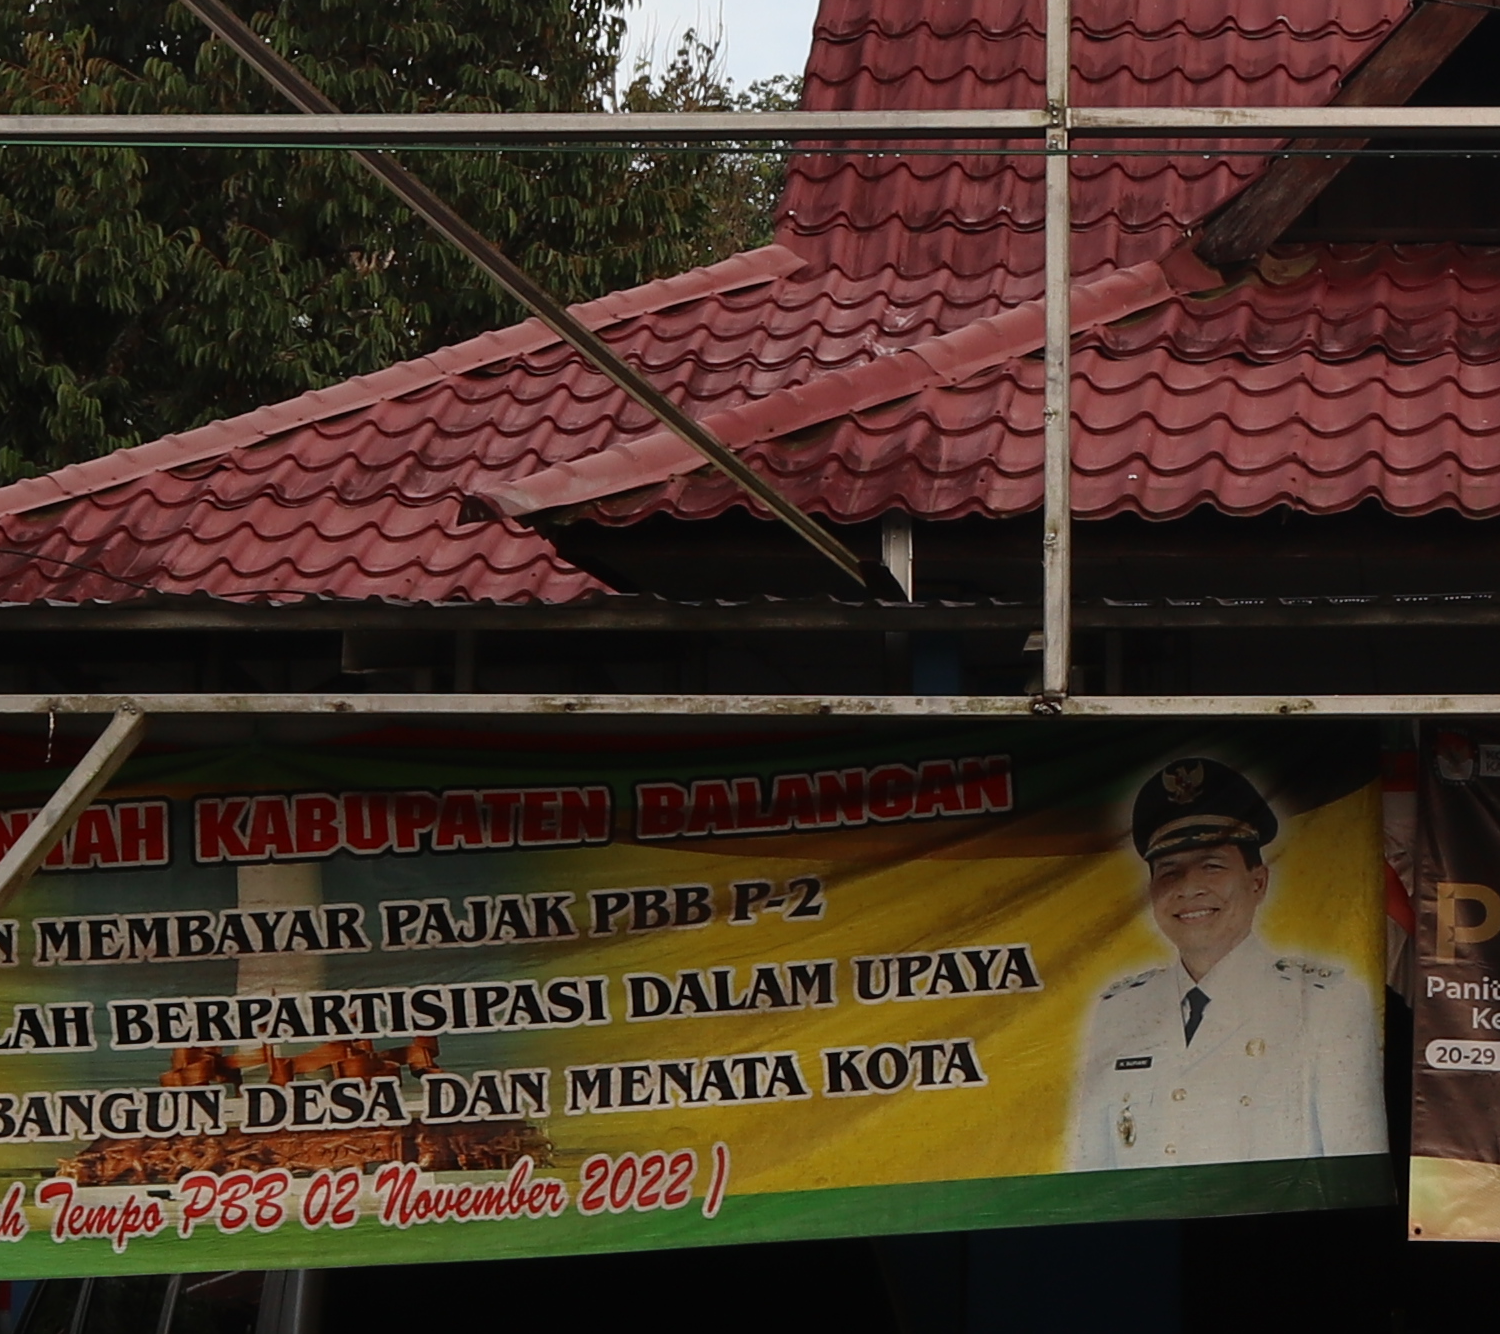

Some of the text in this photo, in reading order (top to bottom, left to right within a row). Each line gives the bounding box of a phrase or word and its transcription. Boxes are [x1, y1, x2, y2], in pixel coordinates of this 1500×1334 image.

[199, 788, 610, 859] KABUPATEN
[637, 758, 1011, 838] BALANGAN
[40, 906, 368, 962] MEMBAYAR
[386, 896, 575, 947] PAJAK
[593, 886, 713, 934] PBB
[731, 878, 823, 921] P-2
[115, 979, 604, 1046] BERPARTISIPASI
[629, 964, 835, 1019] DALAM
[854, 946, 1039, 1000] UPAYA
[245, 1085, 406, 1128] DESA
[425, 1073, 547, 1117] DAN
[571, 1054, 805, 1111] MENATA
[827, 1041, 984, 1092] KOTA
[1436, 1046, 1496, 1065] 20-29
[40, 1181, 163, 1251] Tempo
[181, 1174, 289, 1234] PBB
[302, 1173, 361, 1226] 02
[378, 1157, 564, 1226] November
[580, 1149, 698, 1210] 2022
